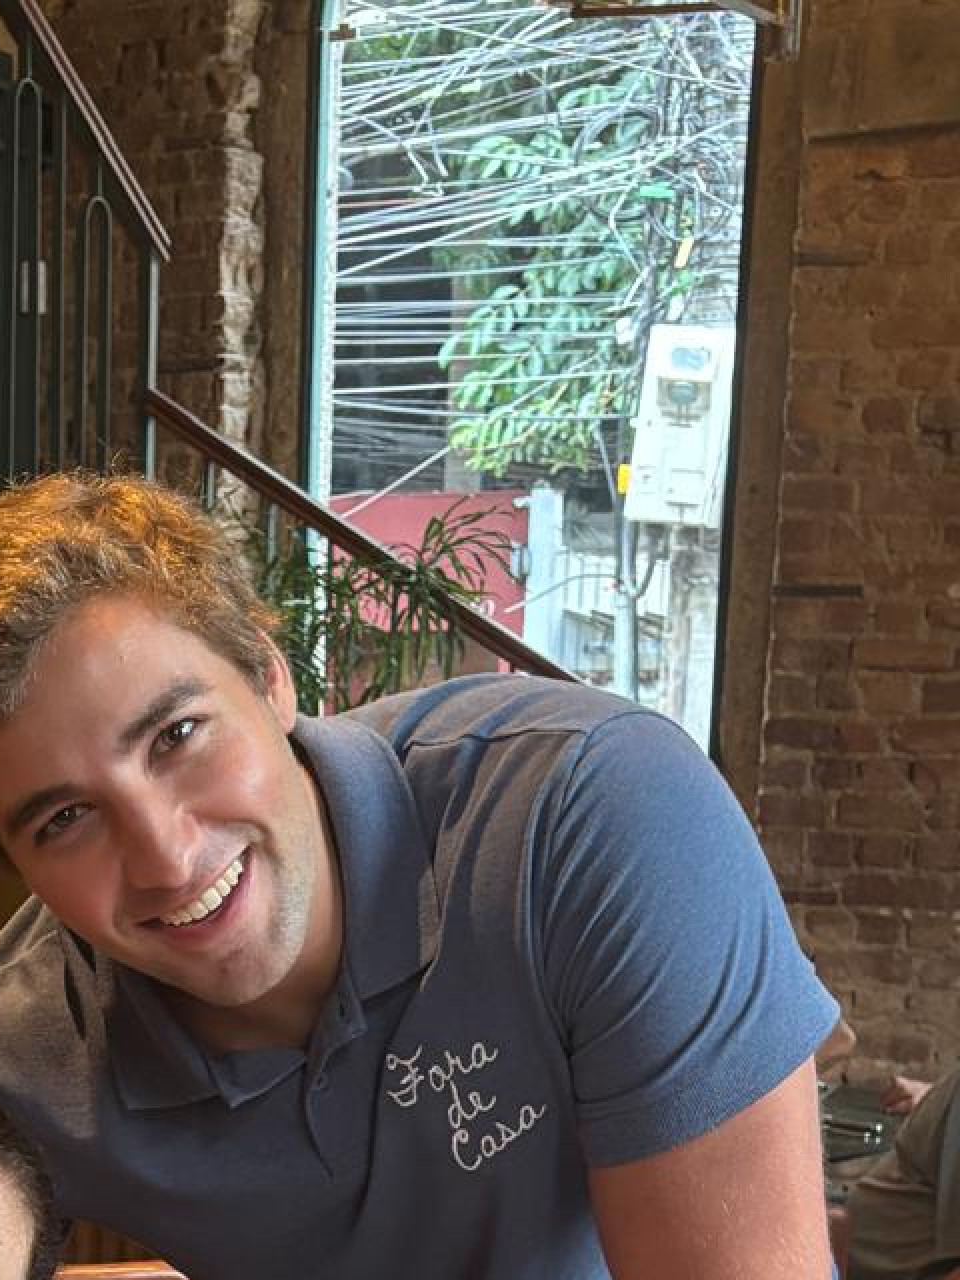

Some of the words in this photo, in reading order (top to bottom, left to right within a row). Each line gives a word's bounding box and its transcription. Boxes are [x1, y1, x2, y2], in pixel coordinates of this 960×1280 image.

[386, 1041, 499, 1106] Fora
[448, 1081, 497, 1128] de
[451, 1104, 547, 1171] Casa
